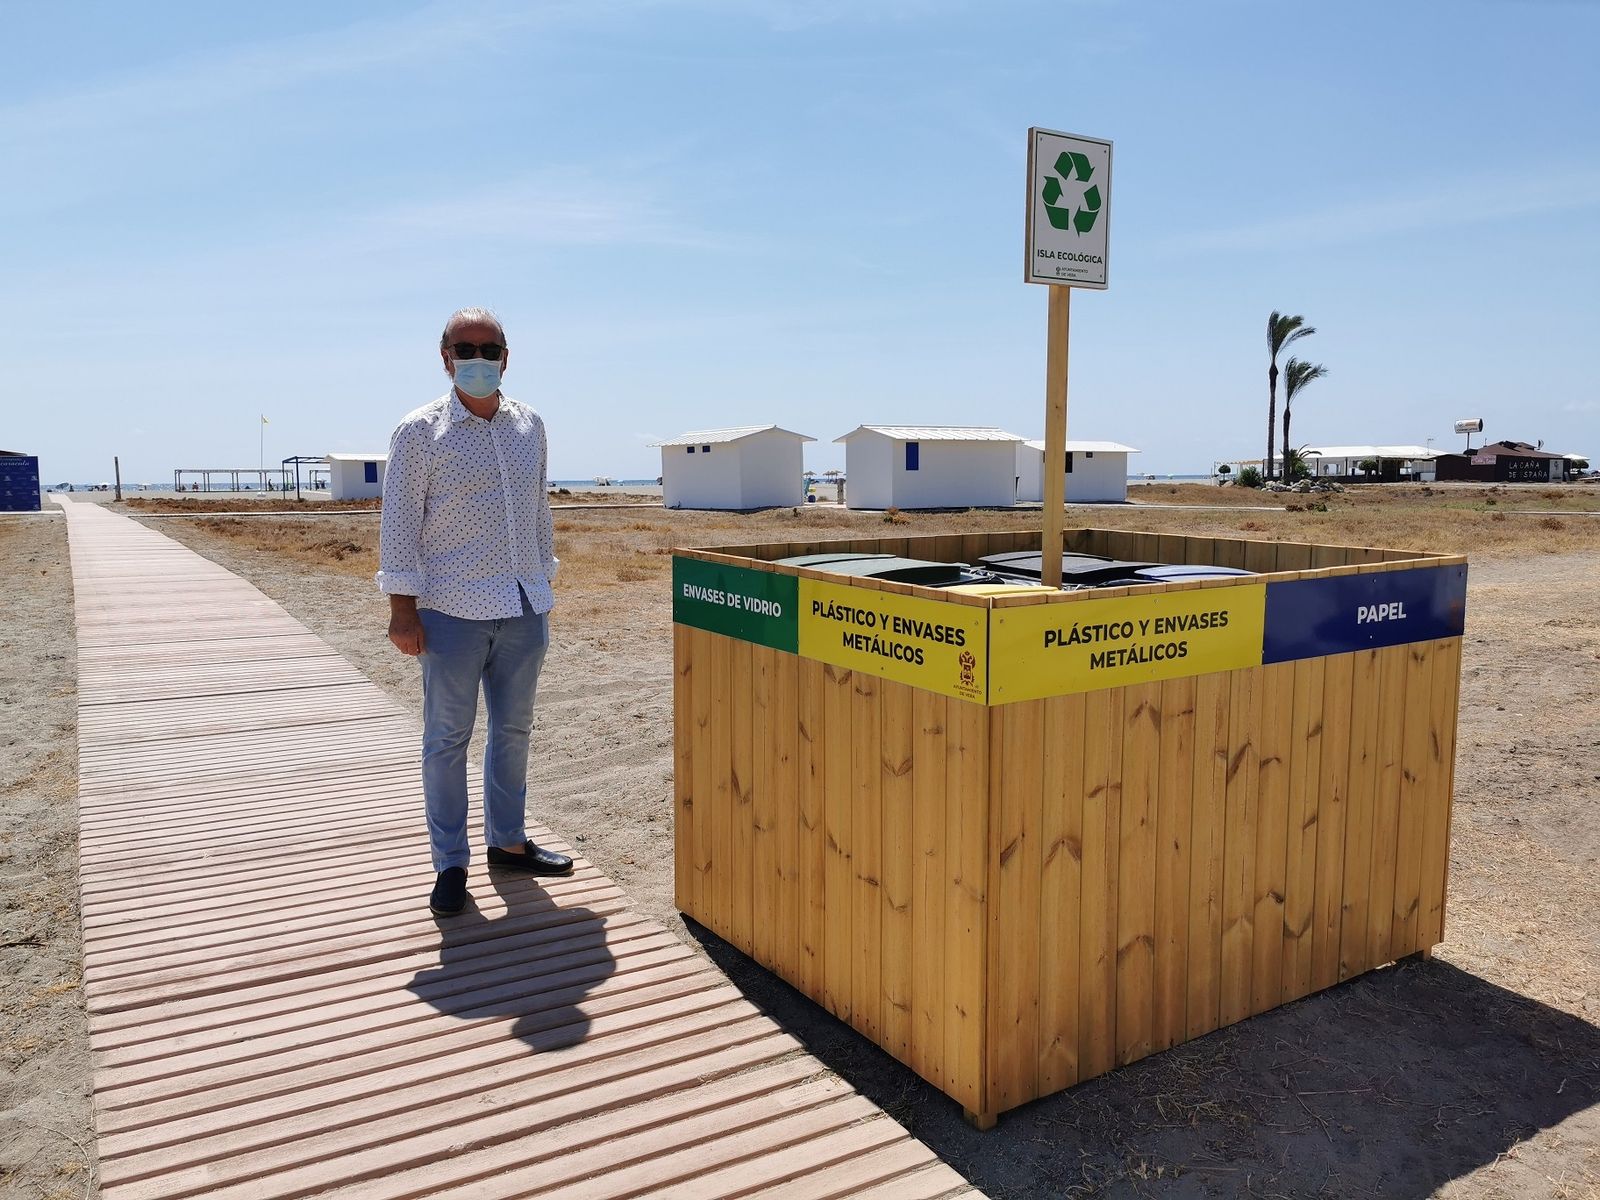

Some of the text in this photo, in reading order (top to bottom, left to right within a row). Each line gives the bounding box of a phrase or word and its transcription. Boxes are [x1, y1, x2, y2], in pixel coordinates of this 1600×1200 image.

[1037, 249, 1103, 264] ISLA ECOLÓGICA
[1508, 460, 1540, 469] LA CAÑA
[1508, 471, 1517, 479] DE
[683, 583, 782, 618] ENVASES DE VIDRIO
[1357, 602, 1407, 625] PAPEL
[812, 600, 966, 647] PLÁSTICO Y ENVASES
[1044, 610, 1229, 648] PLÁSTICO Y ENVASES
[843, 631, 924, 666] METÁLICOS
[1089, 641, 1188, 670] METÁLICOS
[953, 684, 983, 696] AYUNTAMIENTO
